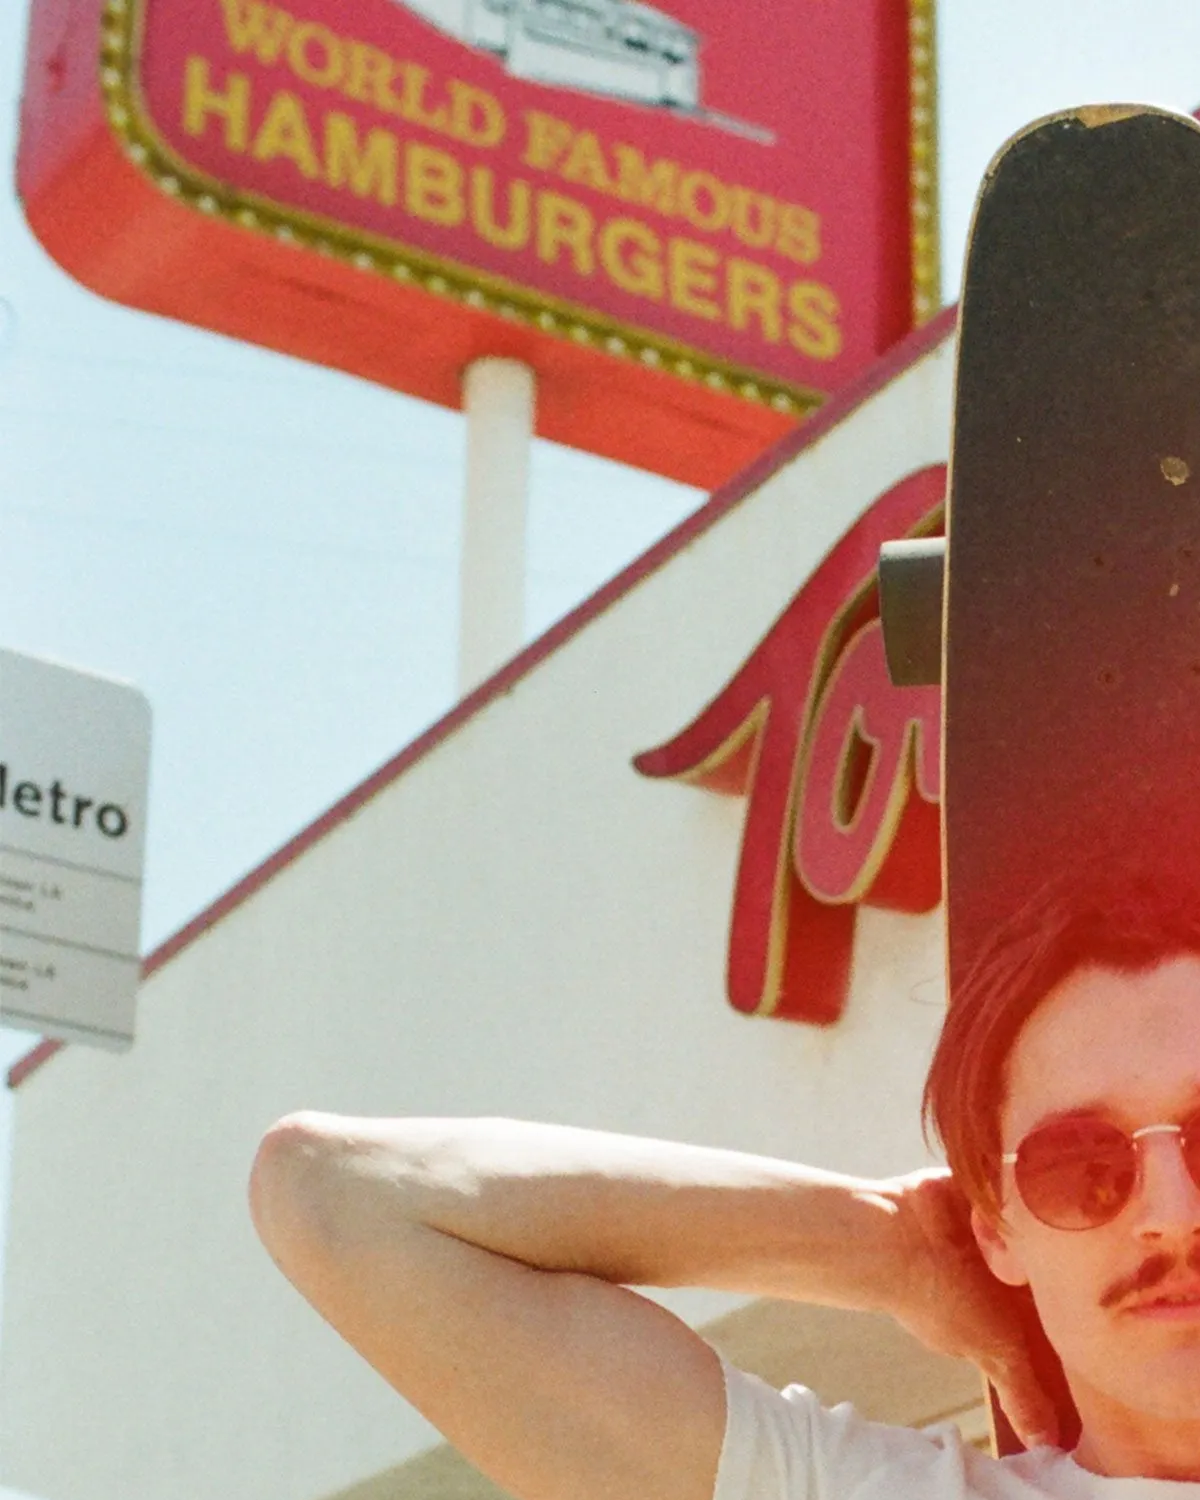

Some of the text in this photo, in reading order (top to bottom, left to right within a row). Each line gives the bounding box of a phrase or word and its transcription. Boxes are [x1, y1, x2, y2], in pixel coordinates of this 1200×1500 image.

[183, 55, 842, 361] HAMBURGERS
[220, 0, 821, 264] WORLD FAMOUS
[0, 762, 129, 838] etro
